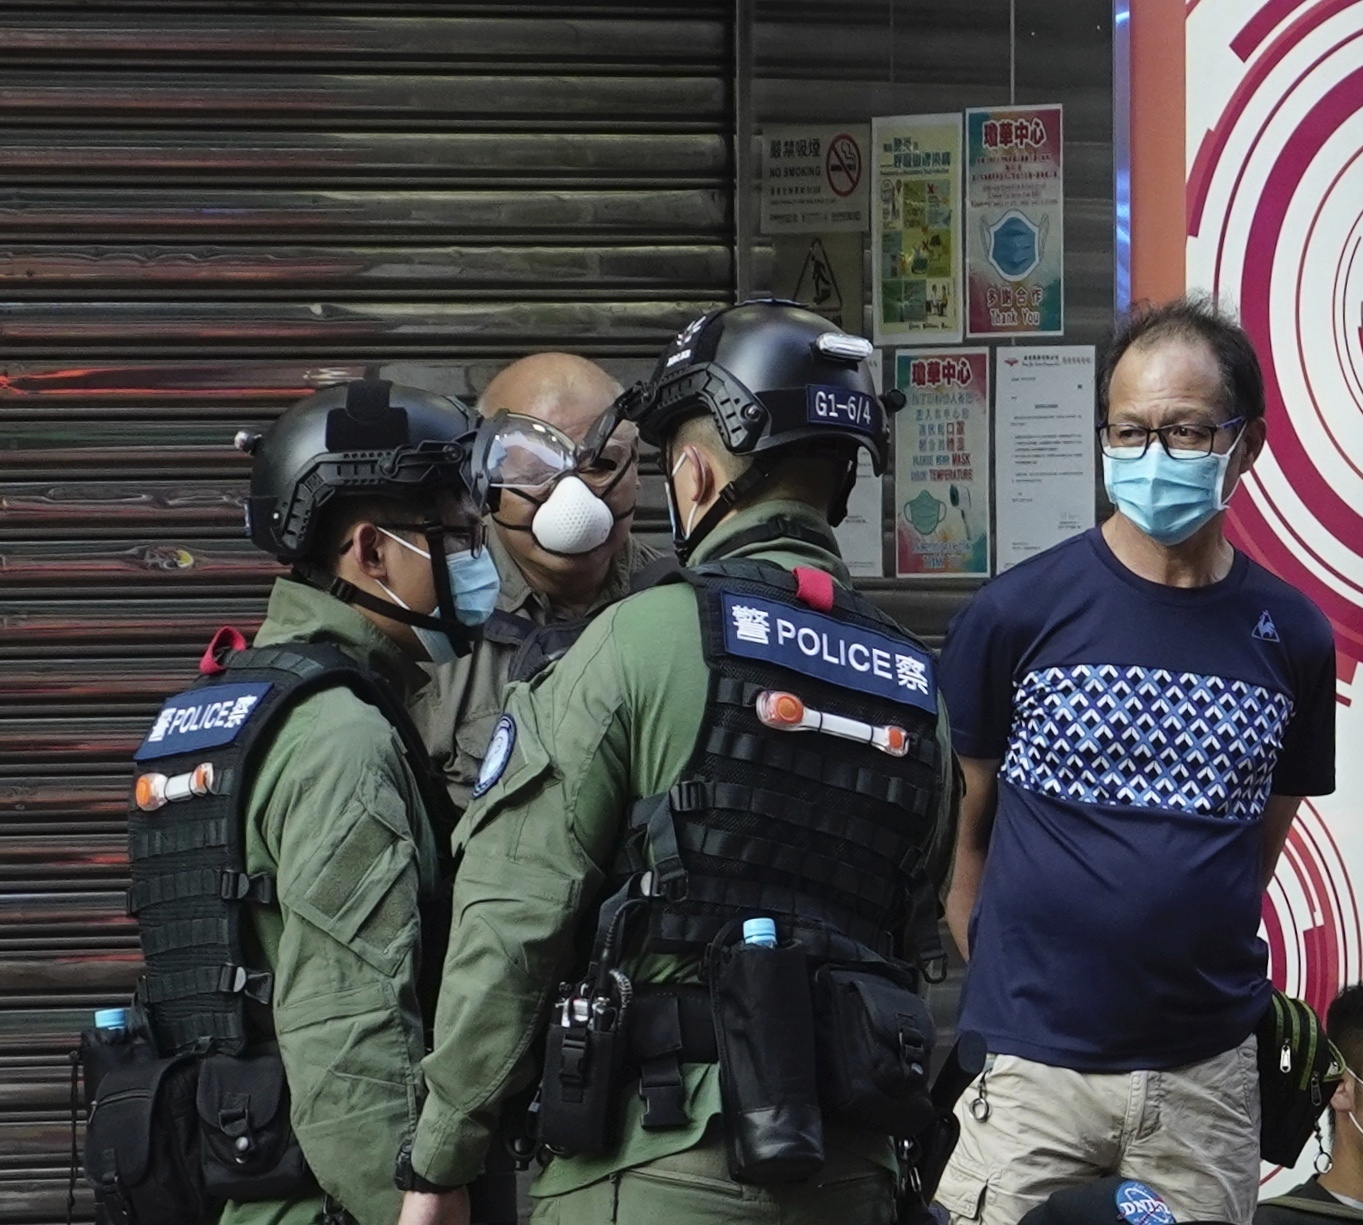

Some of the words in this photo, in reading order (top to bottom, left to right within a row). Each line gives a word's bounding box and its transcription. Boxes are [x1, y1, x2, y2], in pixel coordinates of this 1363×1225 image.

[769, 167, 781, 178] NO
[784, 165, 821, 177] SMOKING
[986, 287, 1042, 307] 多謝合作
[990, 308, 1017, 325] Thank
[1021, 308, 1040, 325] You
[814, 391, 872, 424] G1-6/4
[952, 453, 972, 466] MASK
[930, 469, 974, 481] TEMPERATURE
[731, 604, 770, 645] 警
[776, 617, 892, 681] POLICE
[894, 655, 929, 695] 察
[172, 702, 230, 736] POLICE
